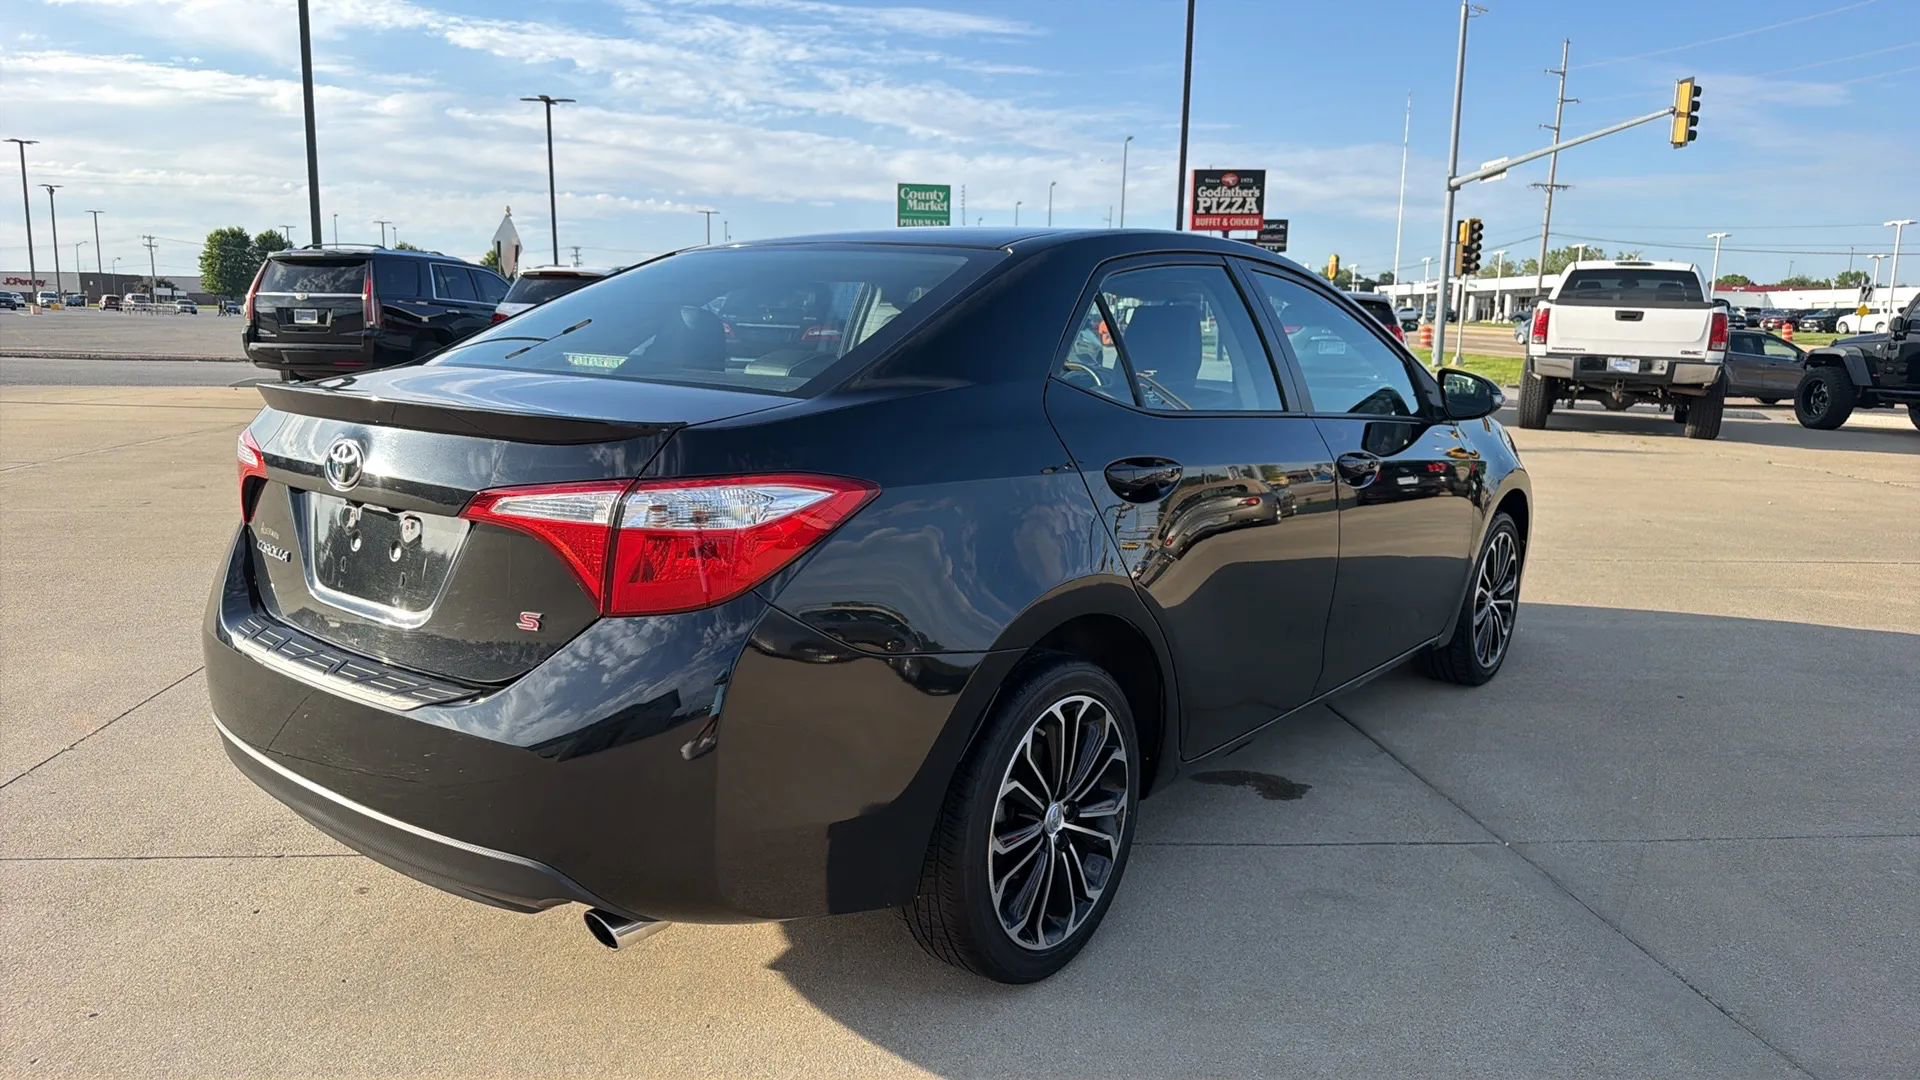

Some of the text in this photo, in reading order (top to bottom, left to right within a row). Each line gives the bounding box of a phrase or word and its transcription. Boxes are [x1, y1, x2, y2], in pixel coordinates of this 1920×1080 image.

[900, 187, 945, 202] County
[1197, 186, 1260, 197] Godfather's
[907, 200, 947, 211] Market
[1196, 197, 1259, 214] PIZZA
[1195, 217, 1259, 226] BUFFET & CHICKEN
[515, 611, 543, 632] S
